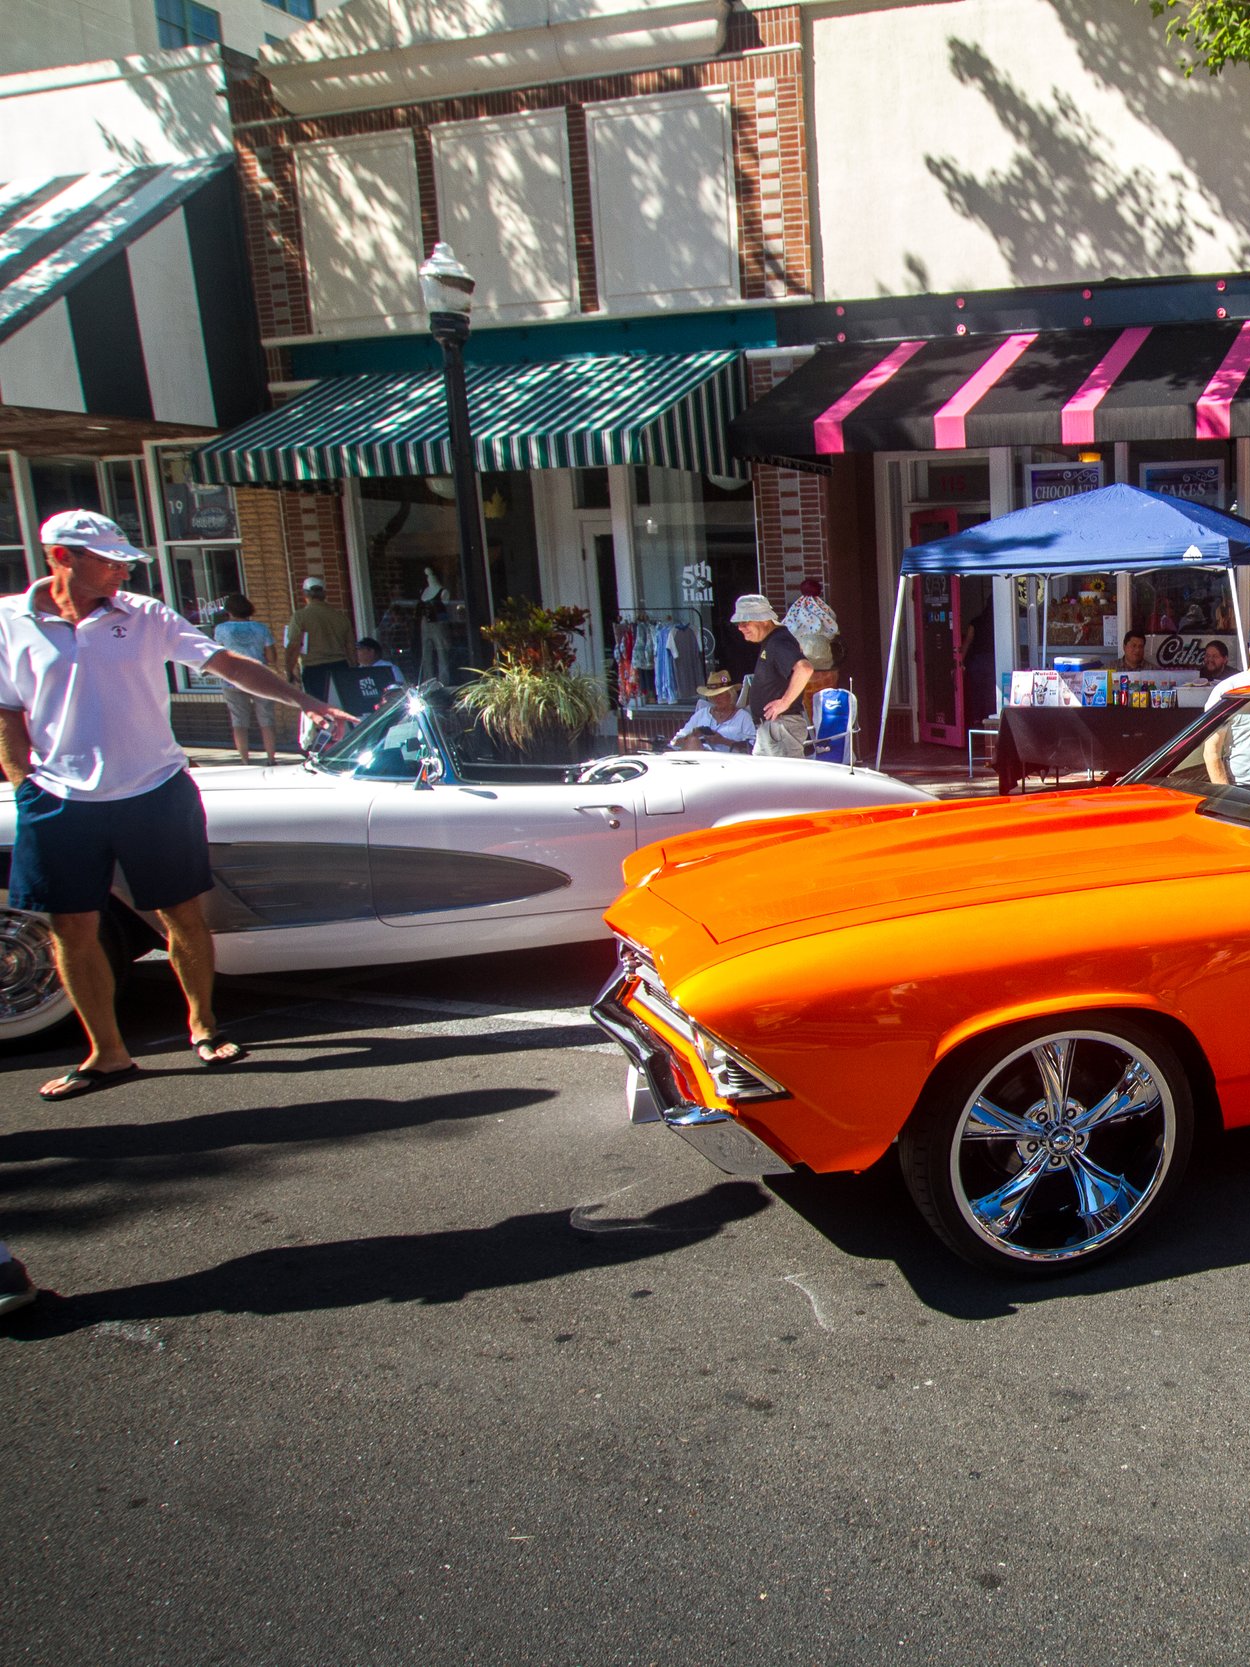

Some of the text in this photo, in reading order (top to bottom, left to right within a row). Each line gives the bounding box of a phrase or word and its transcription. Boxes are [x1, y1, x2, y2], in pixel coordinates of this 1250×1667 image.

[1159, 482, 1206, 498] CAKES
[681, 560, 712, 587] 5th
[696, 579, 705, 588] &
[683, 587, 714, 602] Hall
[360, 677, 375, 689] 5th
[361, 689, 378, 697] Hall
